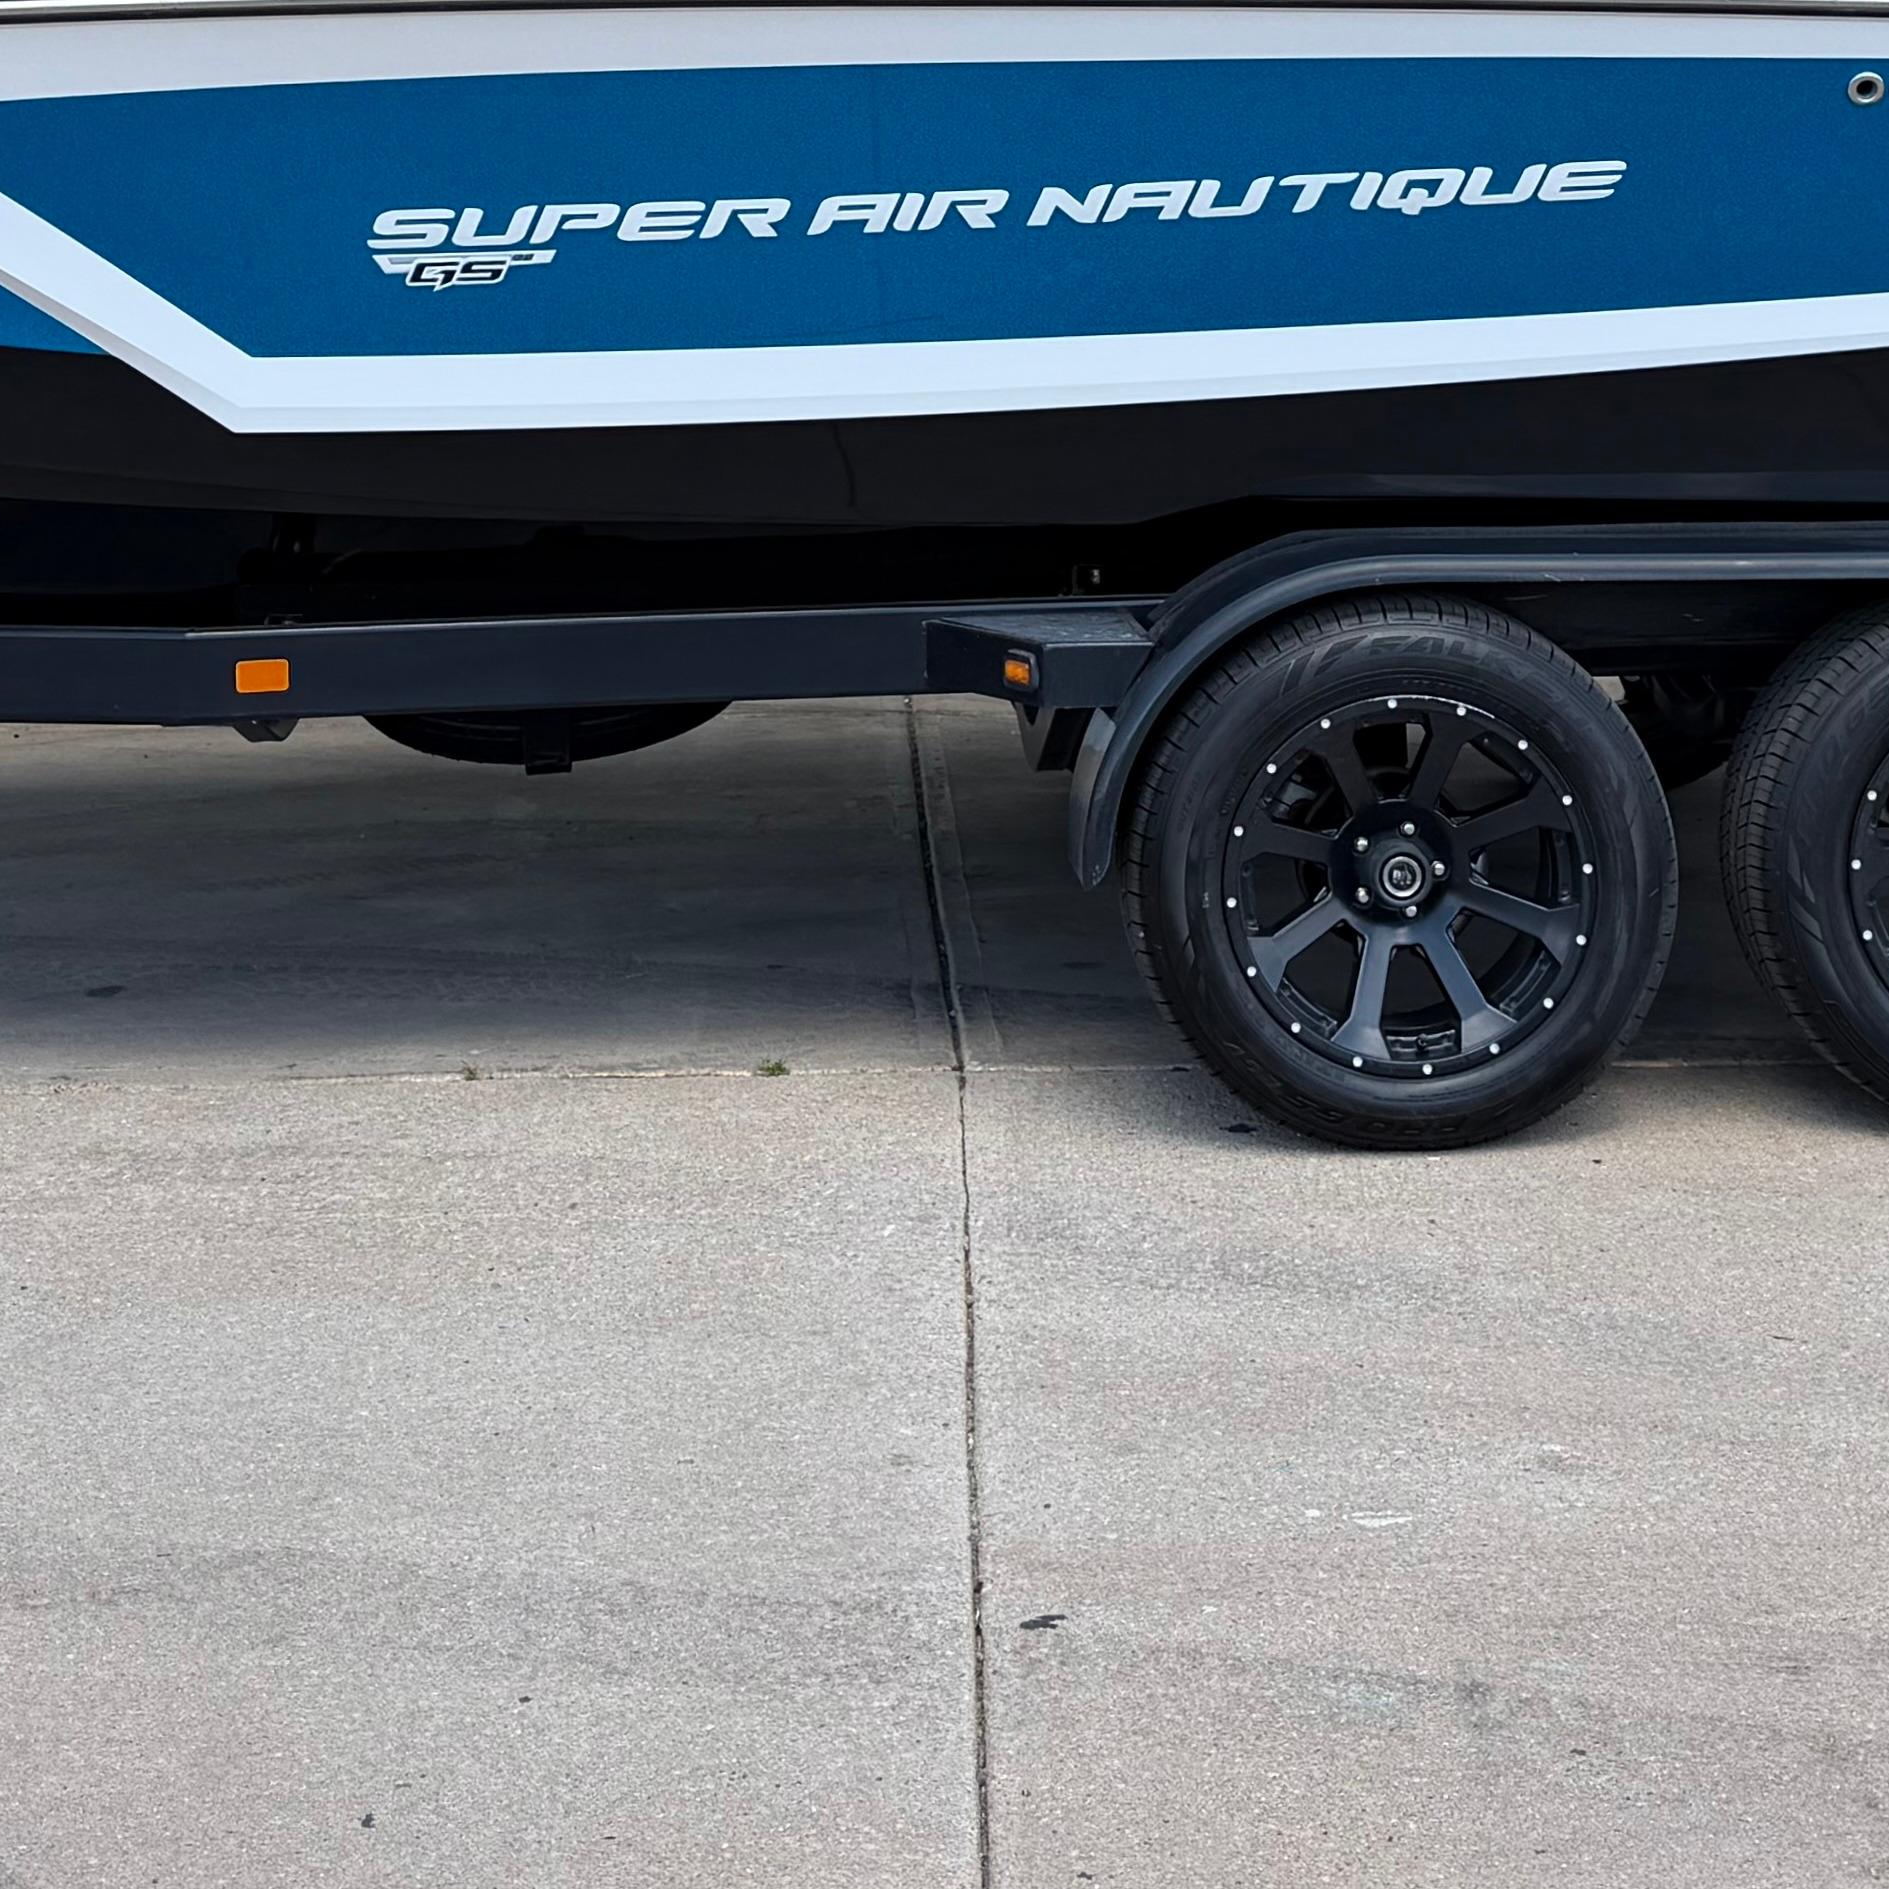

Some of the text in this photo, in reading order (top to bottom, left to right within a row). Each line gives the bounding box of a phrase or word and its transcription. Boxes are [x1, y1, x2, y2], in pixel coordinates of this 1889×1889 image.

[366, 159, 1628, 249] SUPER AIR NAUTIQUE
